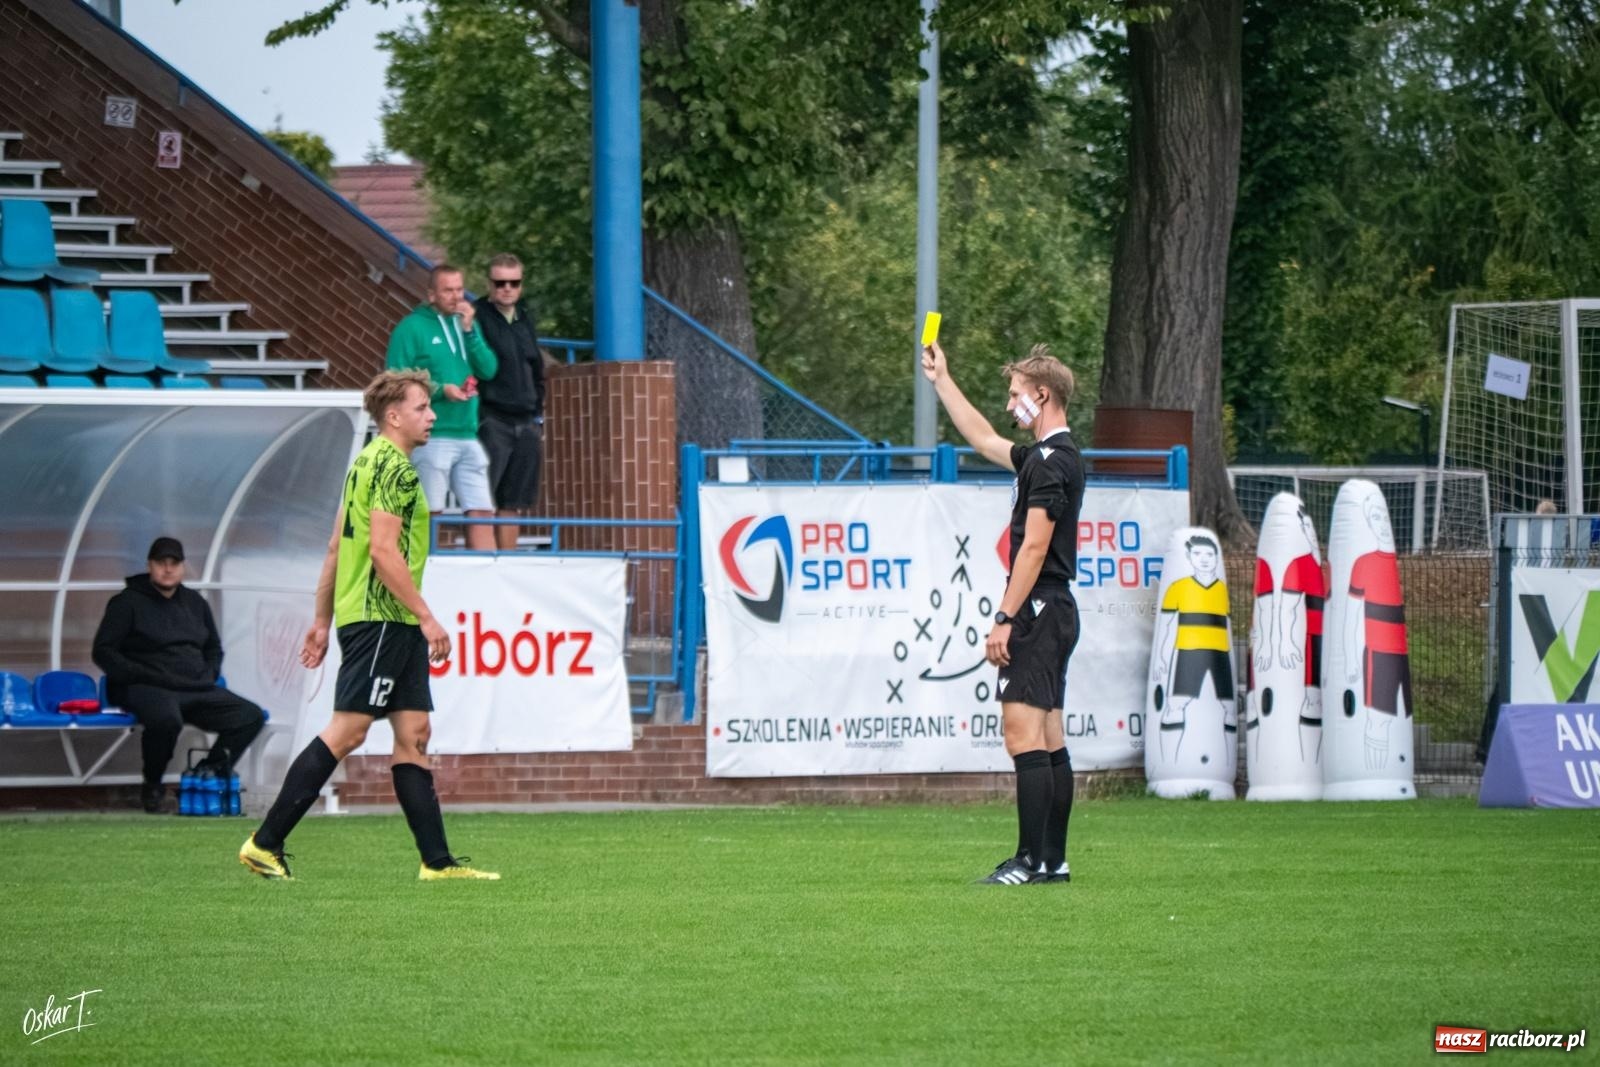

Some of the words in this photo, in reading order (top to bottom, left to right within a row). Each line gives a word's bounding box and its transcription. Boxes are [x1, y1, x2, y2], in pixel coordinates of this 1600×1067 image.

[801, 522, 869, 554] PRO
[1077, 521, 1141, 552] PRO
[801, 558, 912, 591] SPORT
[823, 605, 886, 619] ACTIVE
[369, 676, 395, 707] 12
[726, 717, 832, 743] SZKOLENIA
[843, 715, 956, 740] WSPIERANIE
